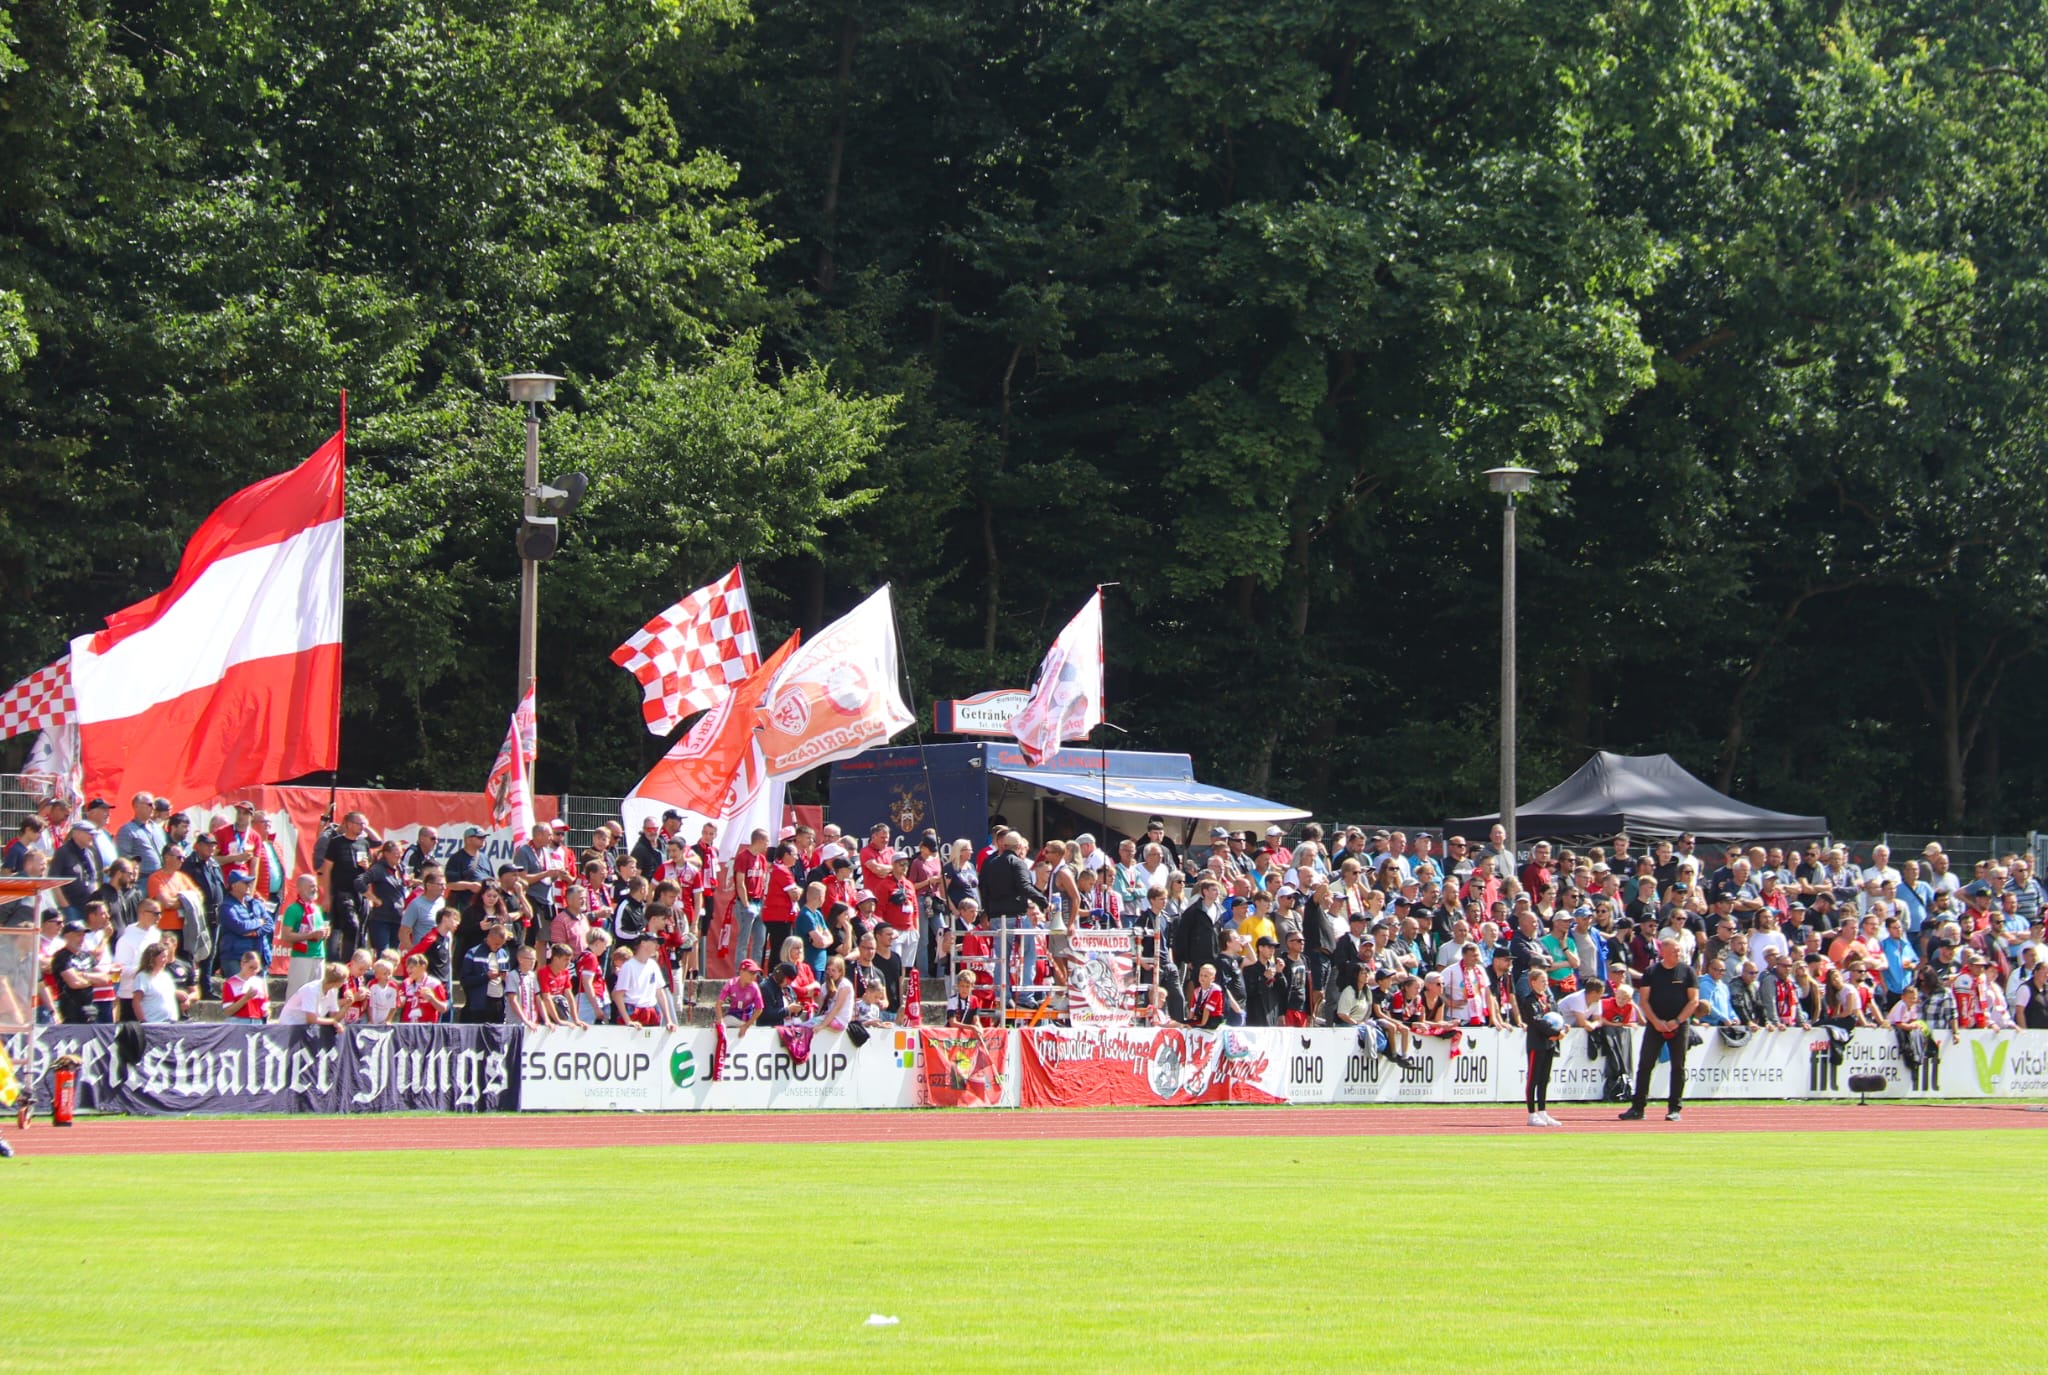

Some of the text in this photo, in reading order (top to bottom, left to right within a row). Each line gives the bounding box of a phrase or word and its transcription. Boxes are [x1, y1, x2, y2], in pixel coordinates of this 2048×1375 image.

[961, 706, 1013, 720] Getränke
[1846, 1042, 1898, 1060] FÜHL DIC
[351, 1028, 509, 1108] Jungs
[1290, 1055, 1323, 1083] JOHO
[1344, 1055, 1379, 1083] JOHO
[1400, 1055, 1434, 1083] JOHO
[1454, 1055, 1488, 1083] JOHO
[1684, 1068, 1783, 1082] ORSTEN REYHER
[584, 1087, 648, 1098] UNSERE ENERGIE
[784, 1087, 846, 1097] UNSERE ENERGIE
[1312, 1089, 1323, 1097] BAR
[1453, 1088, 1487, 1096] BROILER BAR
